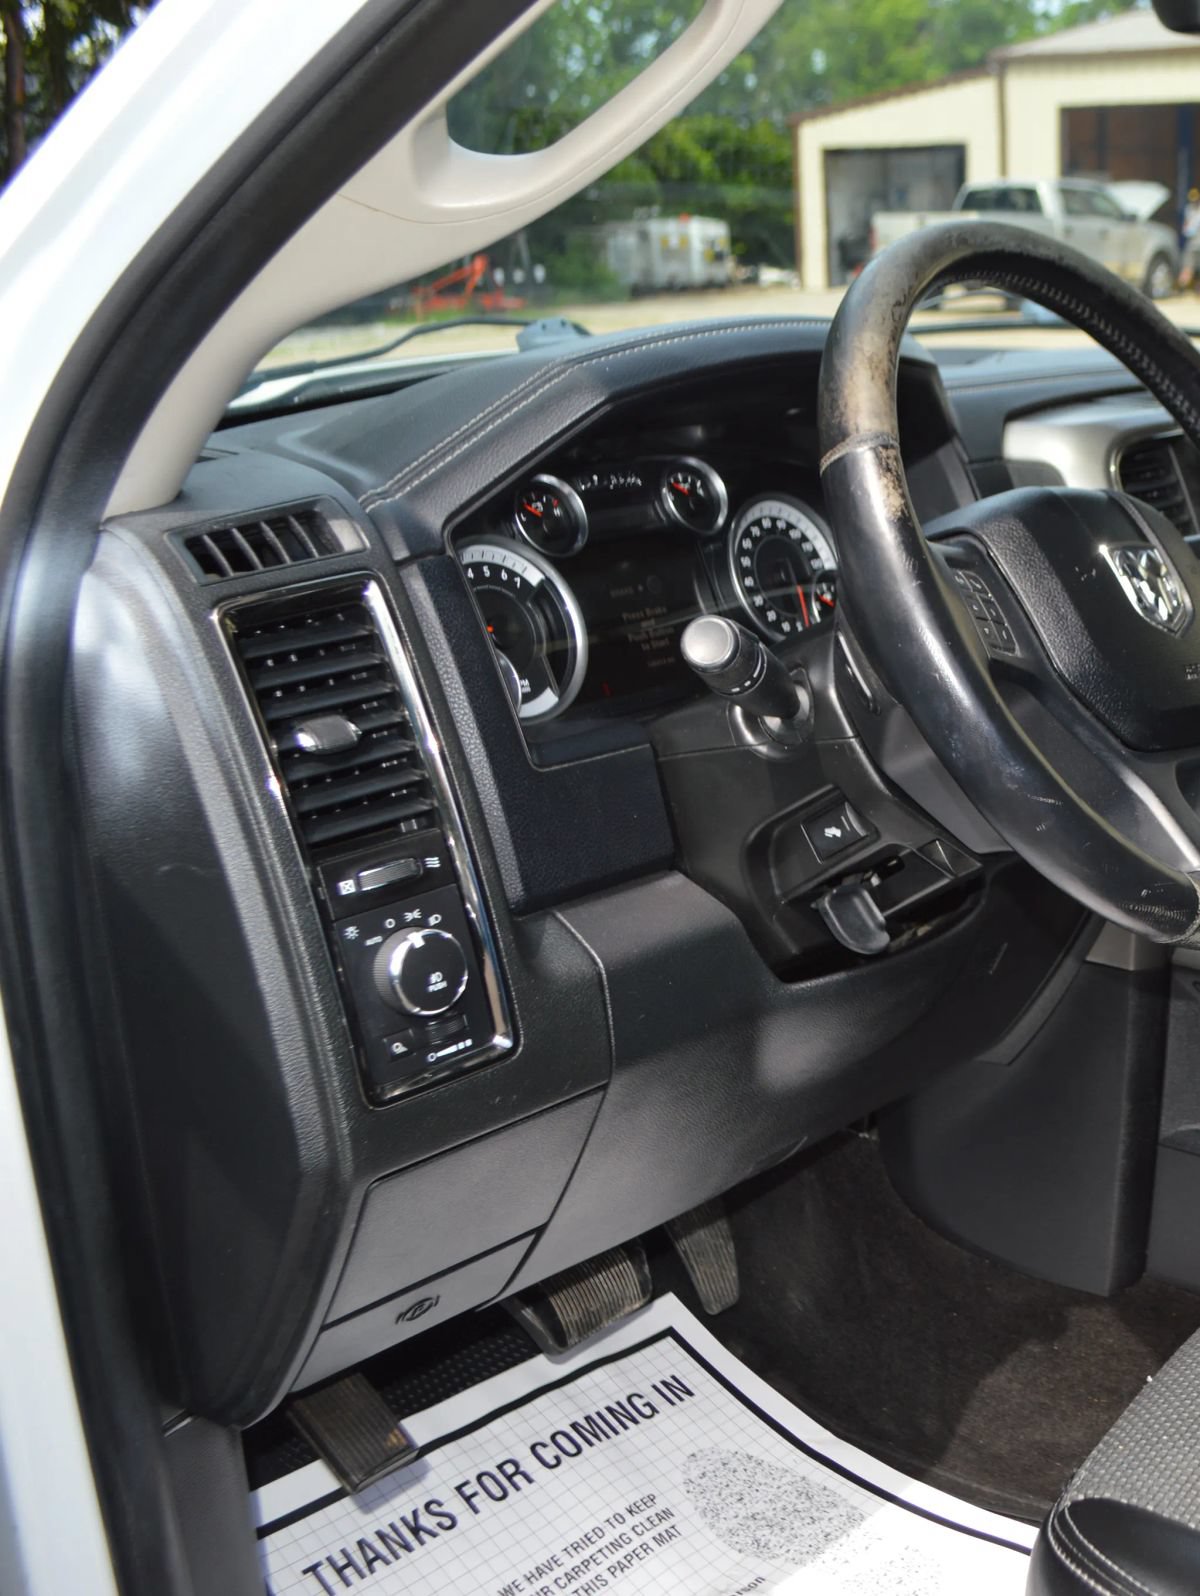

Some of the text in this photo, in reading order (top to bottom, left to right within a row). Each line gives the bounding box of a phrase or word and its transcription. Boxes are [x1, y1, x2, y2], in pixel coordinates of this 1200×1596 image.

[750, 526, 760, 537] 70
[467, 567, 474, 580] 4
[483, 565, 490, 577] 5
[501, 568, 508, 581] 6
[514, 577, 521, 588] 7
[302, 1374, 695, 1596] THANKS FOR COMING IN
[497, 1493, 657, 1596] WE HAVE TRIED TO KEEP
[554, 1532, 632, 1590] CARPETING
[631, 1507, 675, 1537] CLEAN
[572, 1525, 683, 1596] THIS PAPER MAT
[731, 1577, 766, 1596] rson
